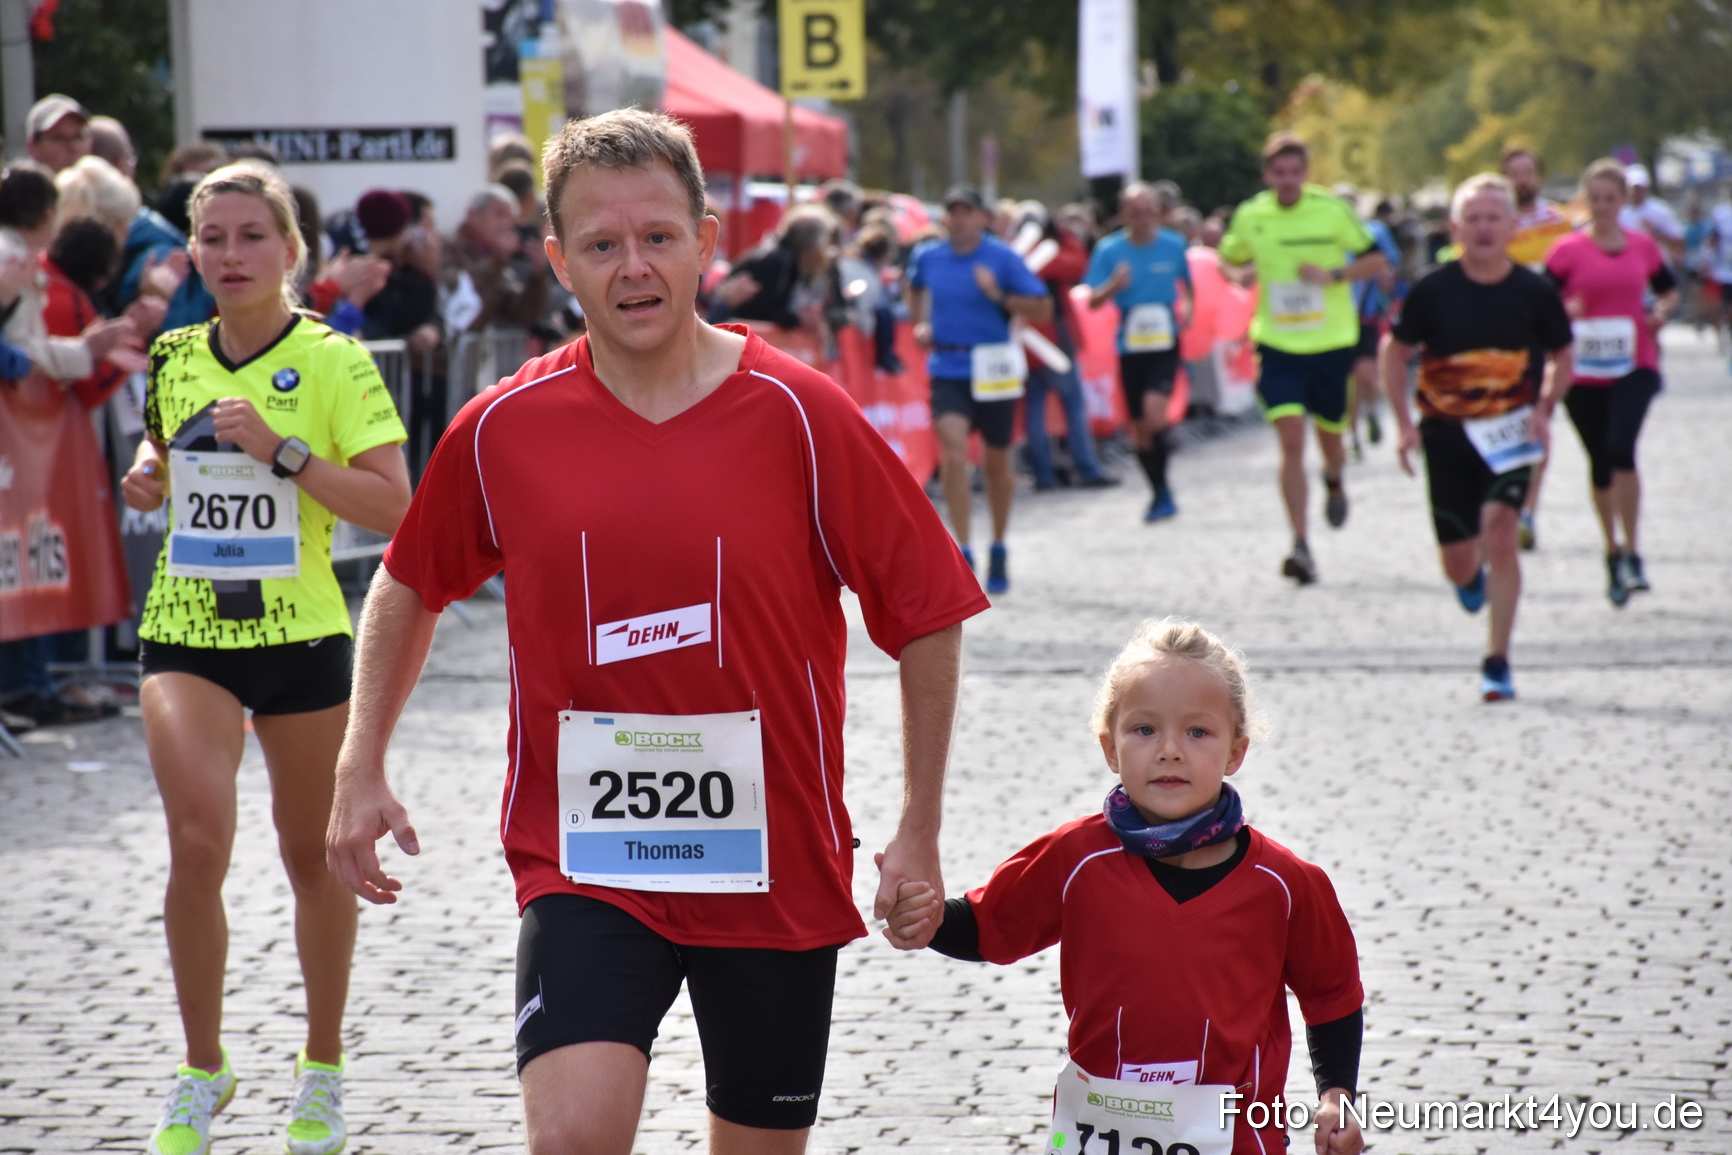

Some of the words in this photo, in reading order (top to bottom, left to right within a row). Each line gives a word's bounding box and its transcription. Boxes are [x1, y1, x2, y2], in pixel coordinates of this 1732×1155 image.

[804, 14, 841, 68] B
[1342, 139, 1367, 173] C
[188, 493, 276, 530] 2670
[213, 544, 245, 557] Julia
[627, 621, 680, 647] DEHN
[634, 731, 702, 747] BOCK
[589, 770, 734, 819] 2520
[571, 813, 579, 824] D
[625, 841, 705, 860] Thomas
[1139, 1070, 1175, 1083] DEHN
[772, 1092, 816, 1102] BROOKS
[1104, 1095, 1173, 1116] BOCK
[1076, 1122, 1200, 1155] 71
